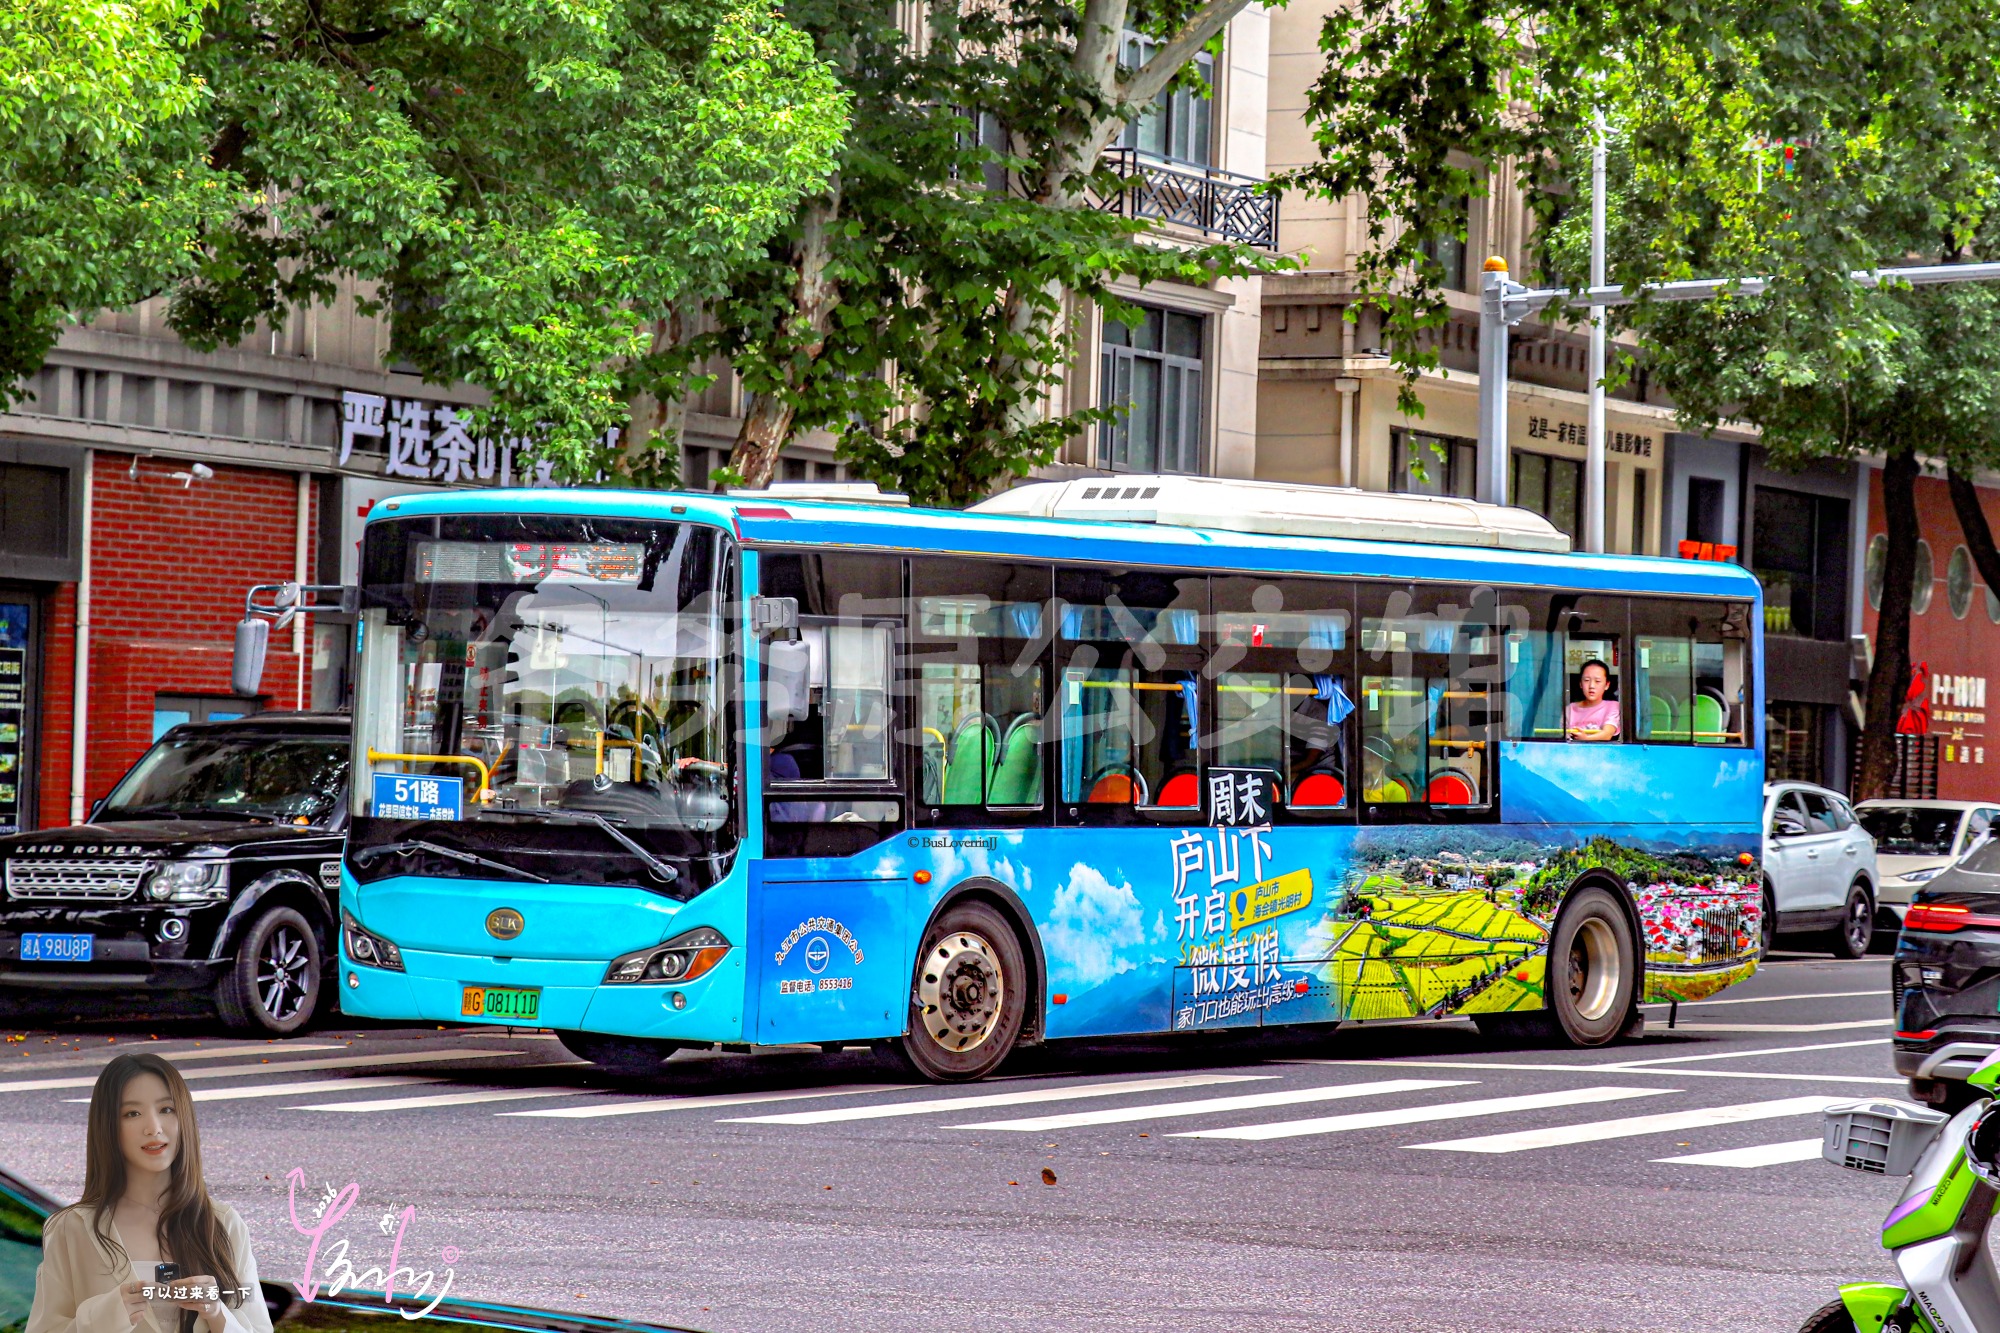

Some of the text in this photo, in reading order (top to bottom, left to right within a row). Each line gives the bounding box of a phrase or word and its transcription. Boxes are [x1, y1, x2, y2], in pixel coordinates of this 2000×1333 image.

[394, 779, 439, 805] 51路
[1208, 773, 1266, 827] 周末
[15, 845, 142, 855] LAND ROVER
[1170, 822, 1272, 899] 庐山下
[1253, 891, 1302, 918] 海会镇光明村
[1255, 881, 1280, 900] 庐山市
[1174, 889, 1226, 942] 开启
[775, 916, 864, 965] 九江市公共交通集团公司
[1190, 929, 1282, 999] 微度假
[1918, 1291, 1945, 1328] MIAOZO
